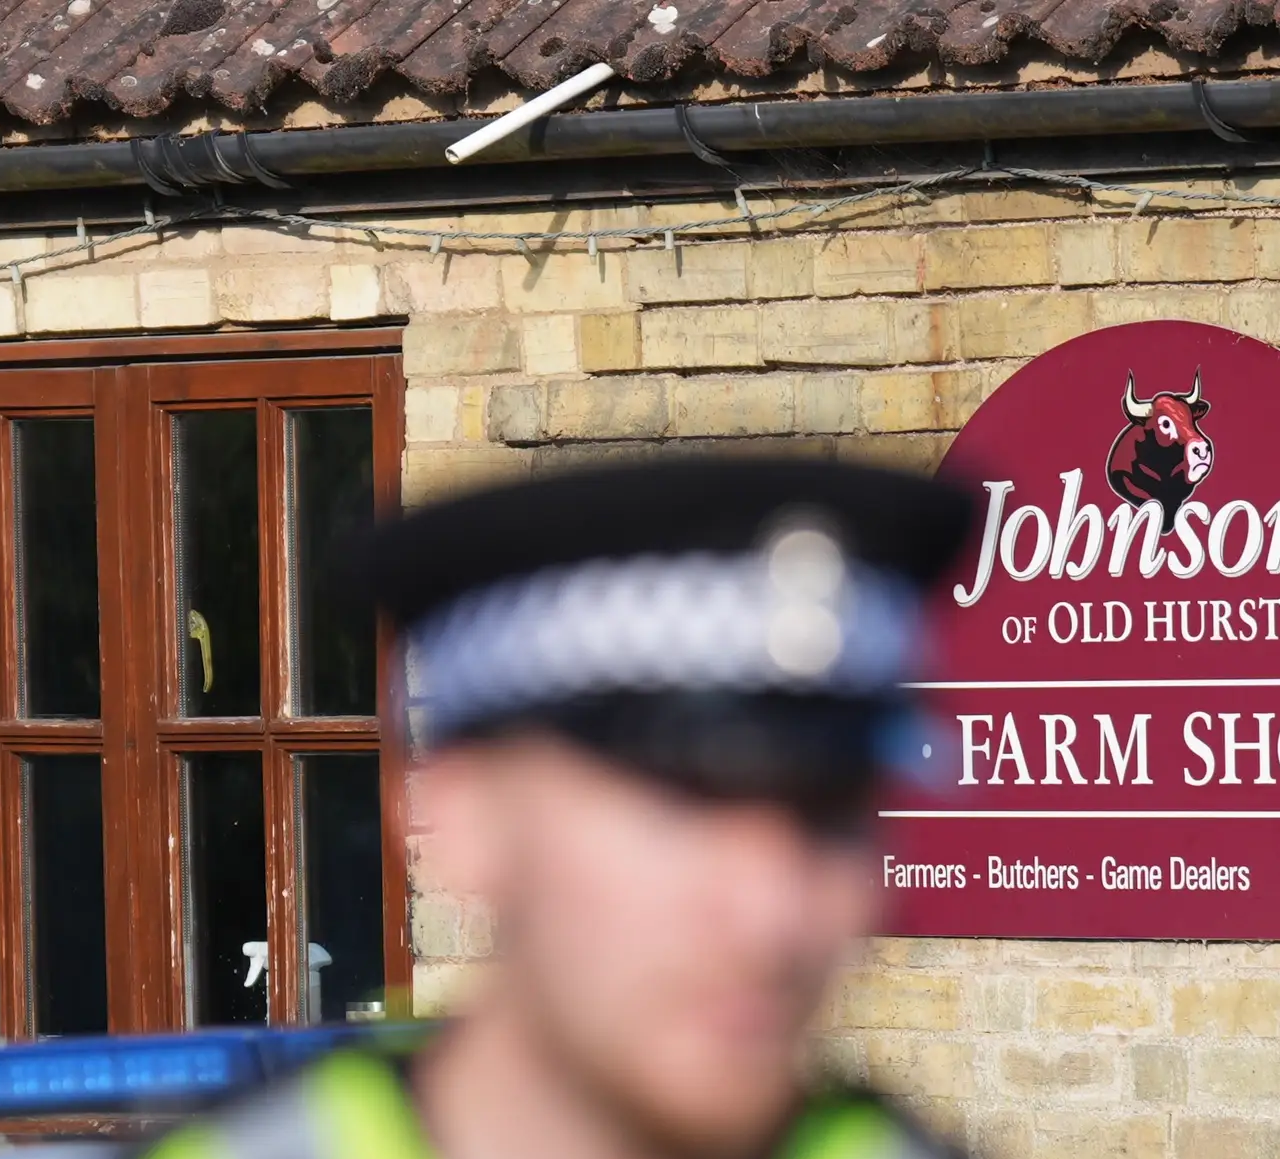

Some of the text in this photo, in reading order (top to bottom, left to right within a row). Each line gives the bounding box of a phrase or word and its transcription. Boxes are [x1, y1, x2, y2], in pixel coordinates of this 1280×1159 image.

[1001, 616, 1037, 645] OF
[1047, 600, 1133, 644] OLD
[956, 711, 1154, 786] FARM
[883, 854, 967, 889] Farmers
[987, 855, 1080, 890] Butchers
[1101, 855, 1163, 891] Game
[1169, 856, 1251, 891] Dealers
